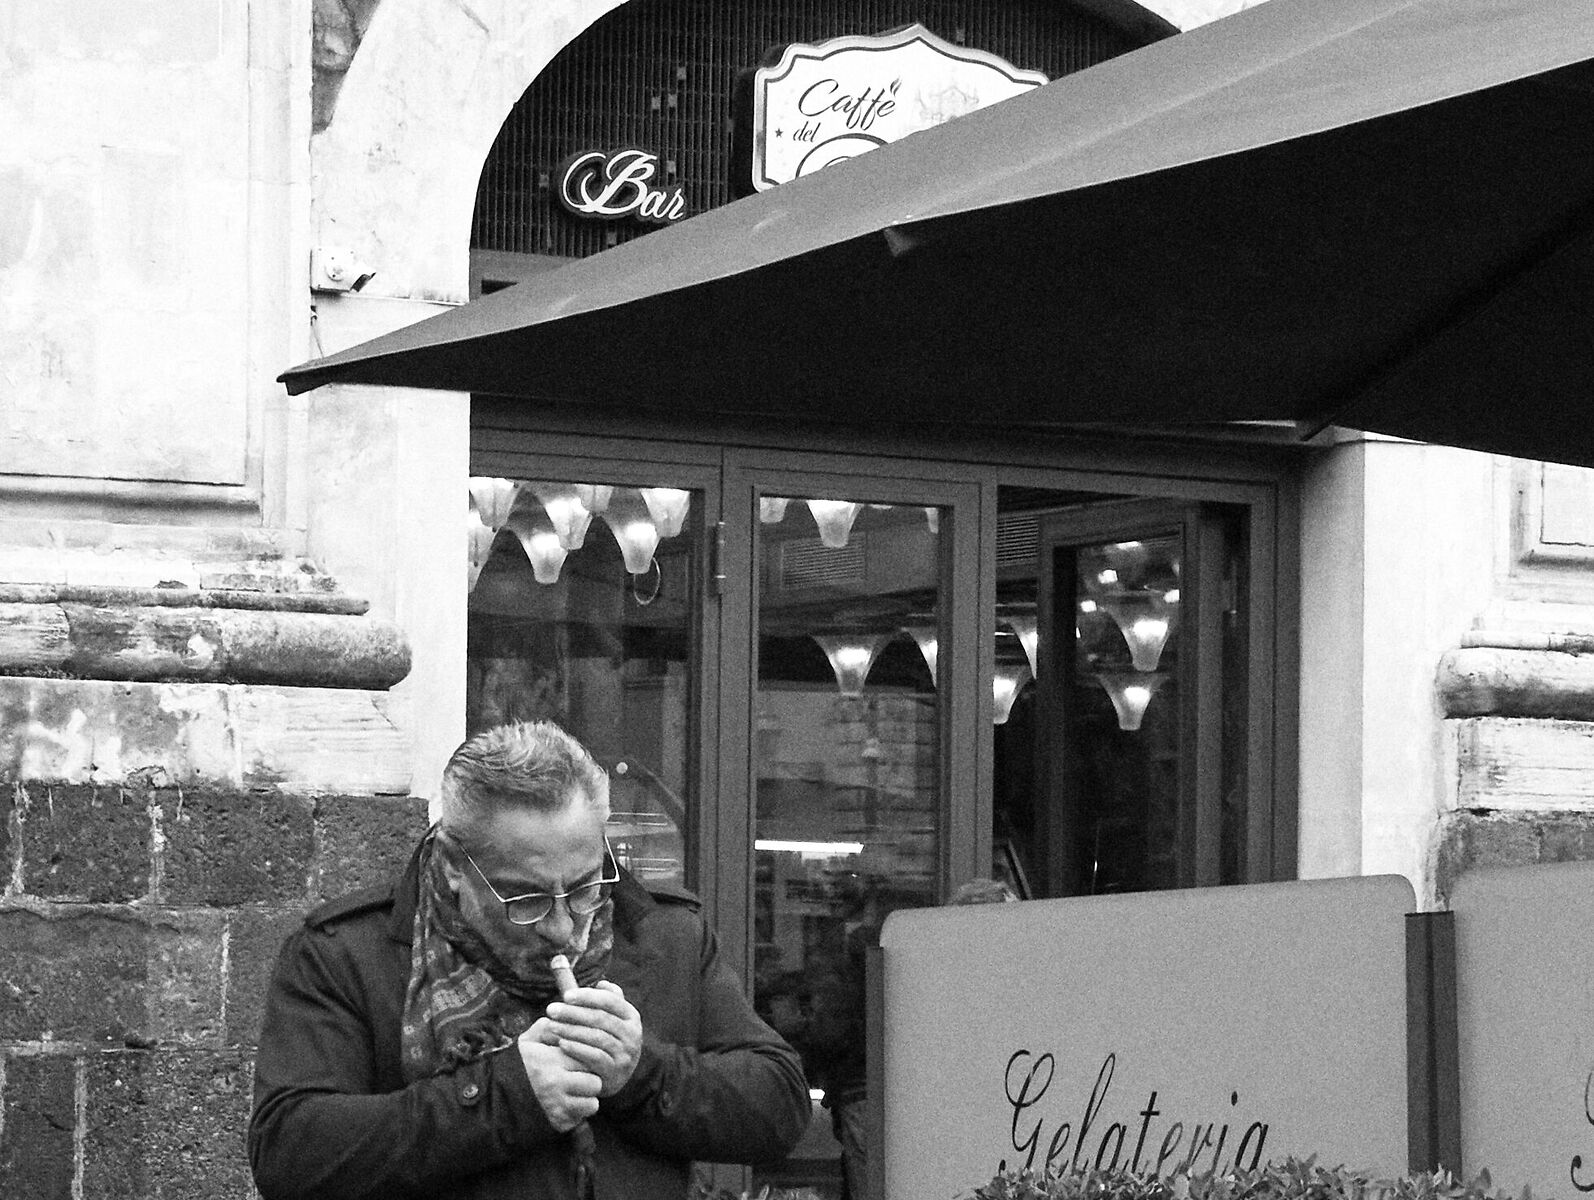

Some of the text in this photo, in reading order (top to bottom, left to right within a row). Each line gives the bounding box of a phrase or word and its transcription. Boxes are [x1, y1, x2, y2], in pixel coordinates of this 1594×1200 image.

[792, 121, 821, 143] del
[562, 149, 685, 220] Bar
[998, 1049, 1269, 1180] Gelateria
